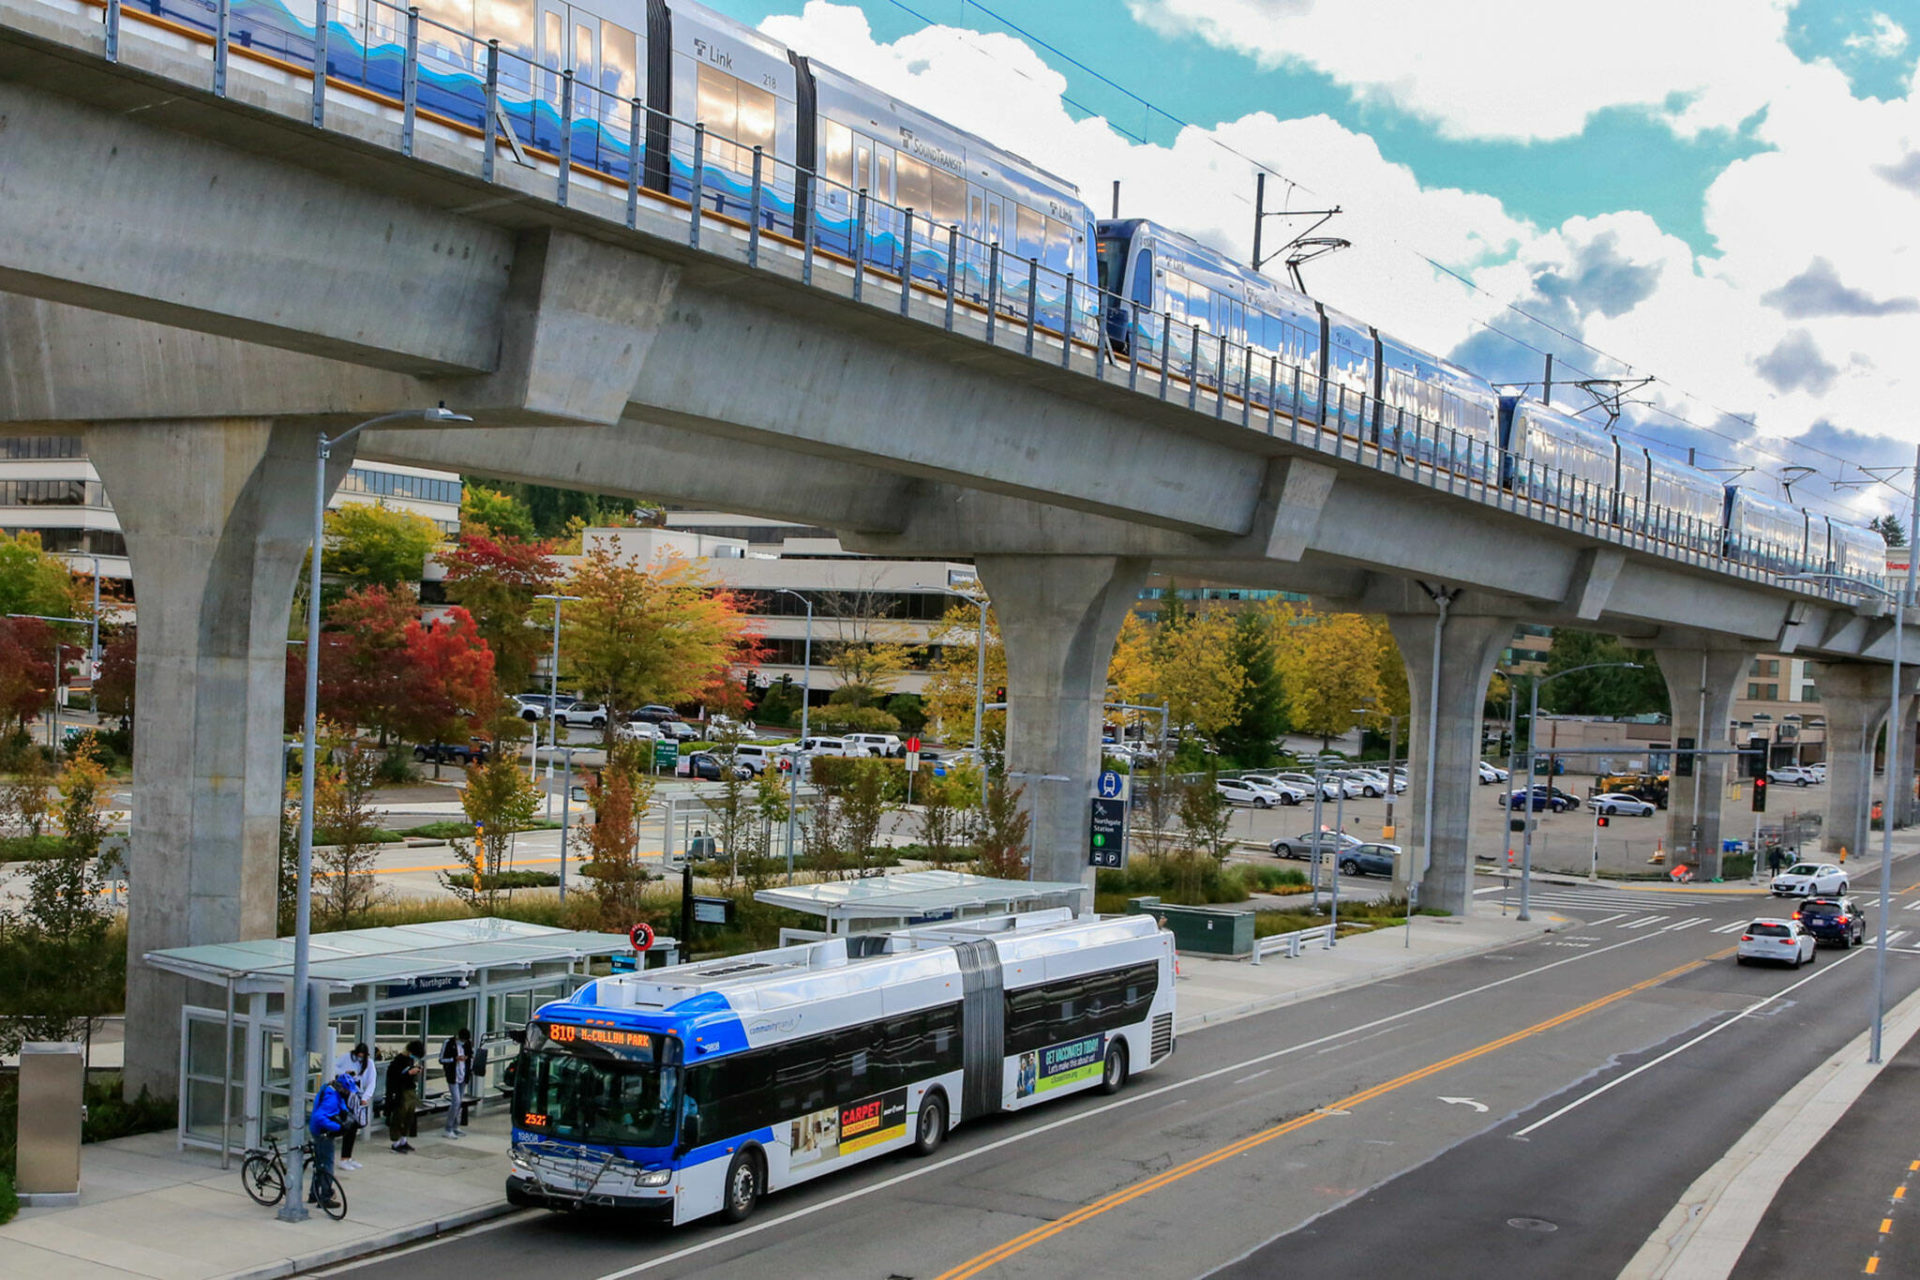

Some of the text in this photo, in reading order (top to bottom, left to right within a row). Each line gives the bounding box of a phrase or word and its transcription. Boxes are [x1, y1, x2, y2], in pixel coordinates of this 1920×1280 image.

[709, 45, 733, 70] Link
[762, 73, 777, 90] 218
[1059, 205, 1073, 224] Link
[1094, 817, 1122, 826] Northgate
[636, 930, 646, 945] 2
[420, 977, 452, 988] Northgate
[550, 1024, 576, 1042] 810
[627, 1033, 650, 1048] PARK
[1045, 1050, 1055, 1065] GET
[841, 1101, 881, 1125] CARPET
[518, 1132, 539, 1143] 19808
